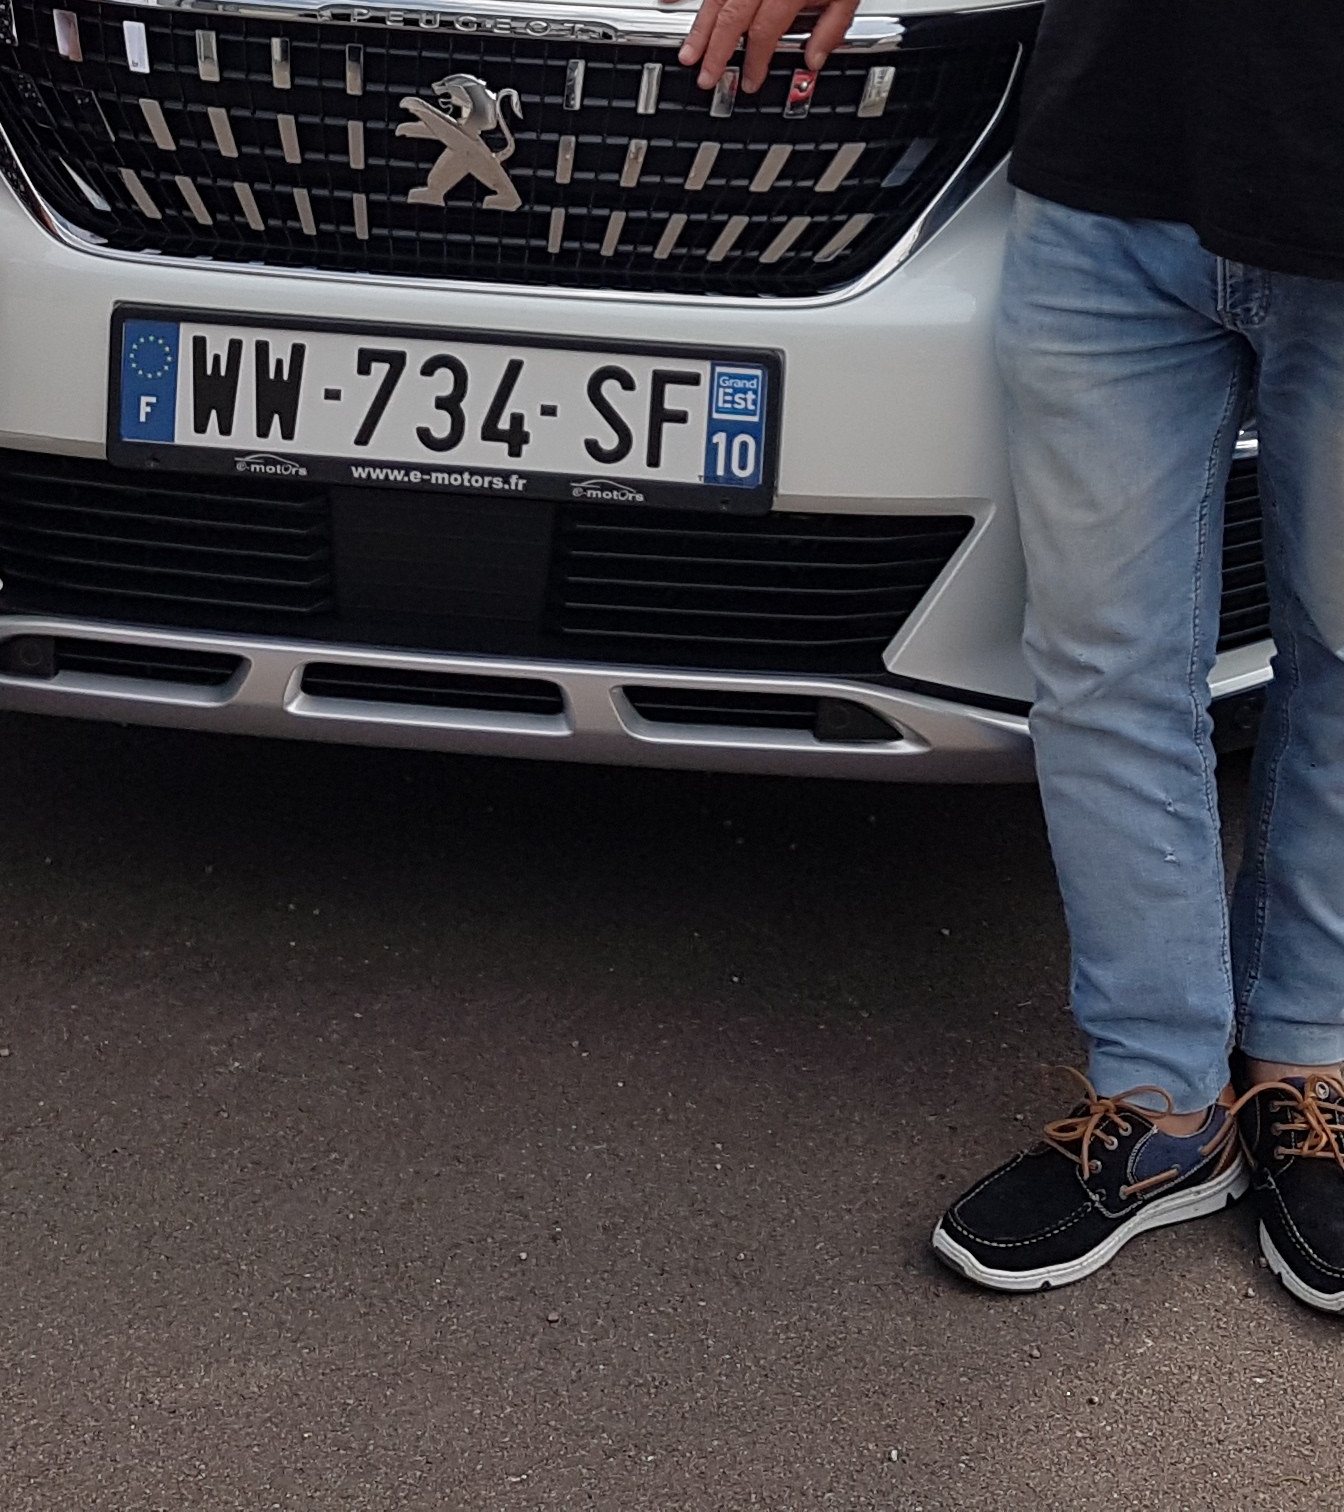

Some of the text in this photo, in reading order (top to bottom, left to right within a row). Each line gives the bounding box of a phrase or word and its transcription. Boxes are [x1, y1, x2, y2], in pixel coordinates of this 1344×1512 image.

[351, 7, 586, 39] PEUGEOT
[719, 376, 758, 389] Grand
[139, 395, 156, 423] F
[717, 388, 756, 410] Est
[712, 431, 756, 478] 10
[236, 462, 307, 477] e-motors
[351, 464, 527, 491] www.e-motors.fr
[572, 488, 644, 503] e-motors
